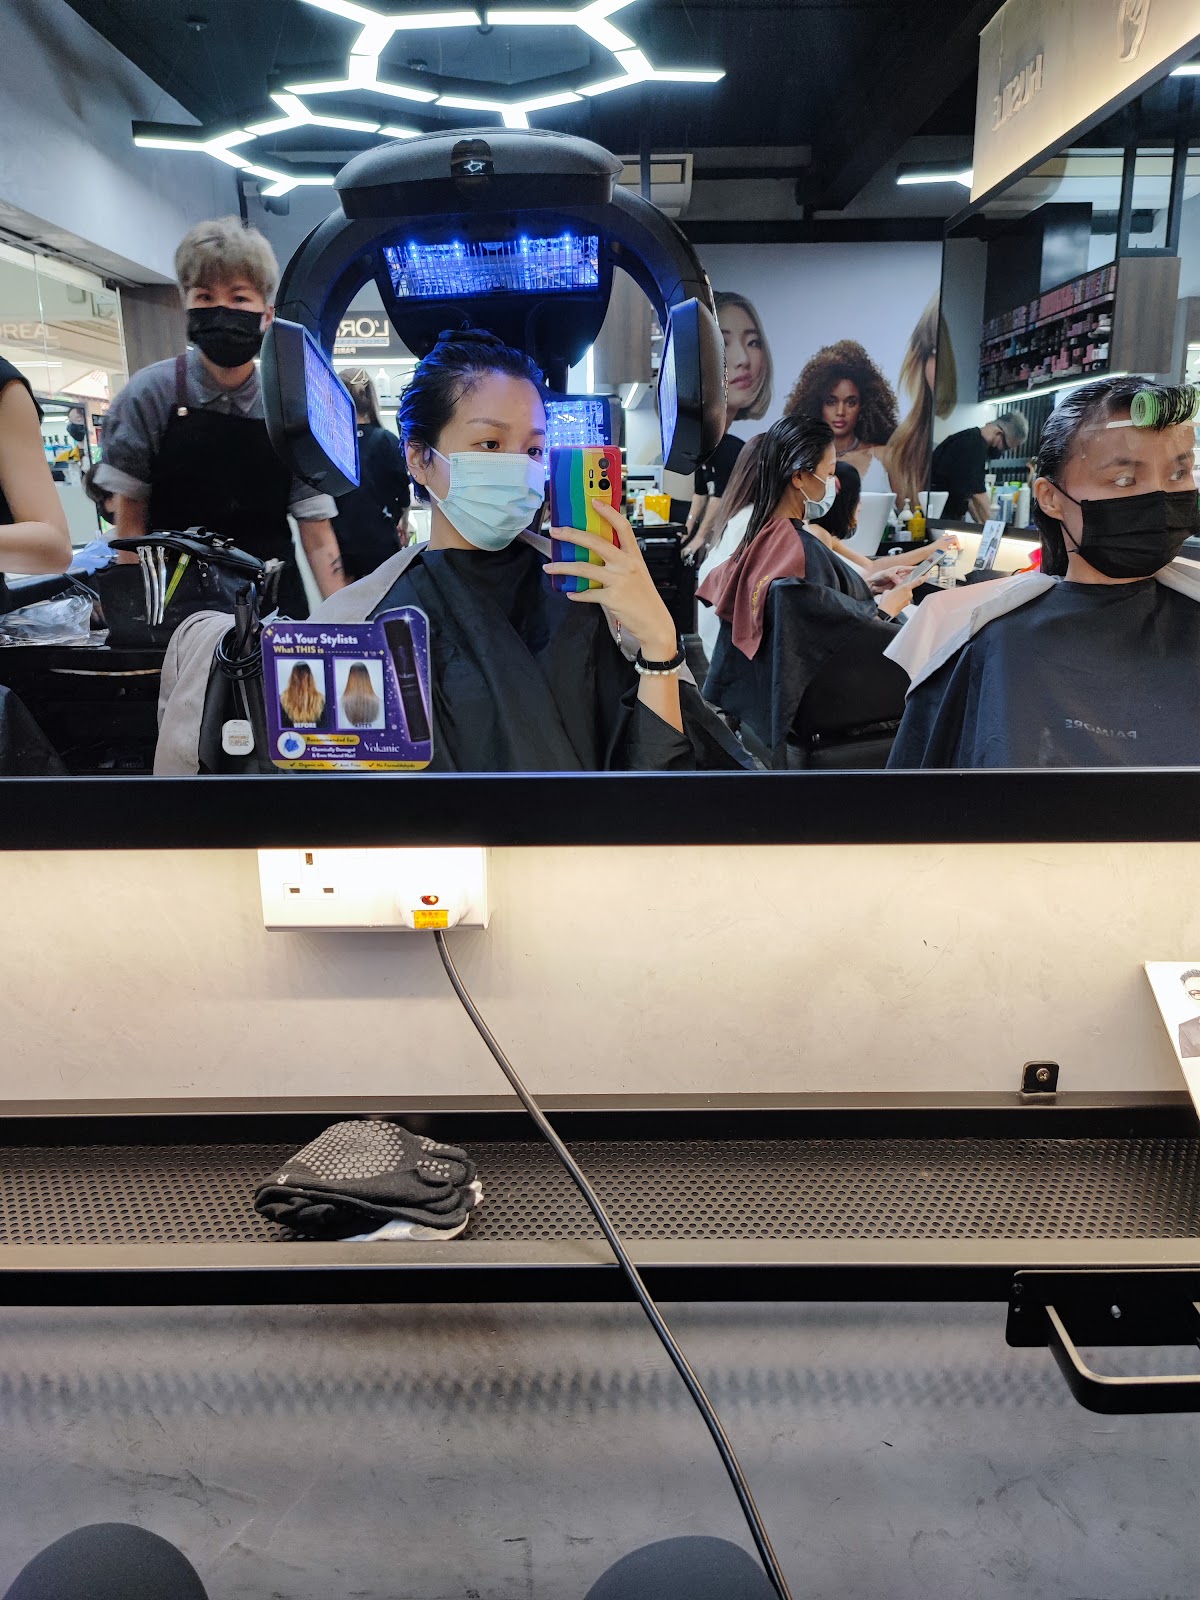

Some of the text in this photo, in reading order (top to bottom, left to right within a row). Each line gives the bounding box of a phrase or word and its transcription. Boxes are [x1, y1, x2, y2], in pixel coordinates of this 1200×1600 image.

[0, 323, 59, 340] REAL
[272, 633, 358, 648] Ask Your Stylists
[295, 646, 316, 654] THIS
[317, 646, 324, 654] is
